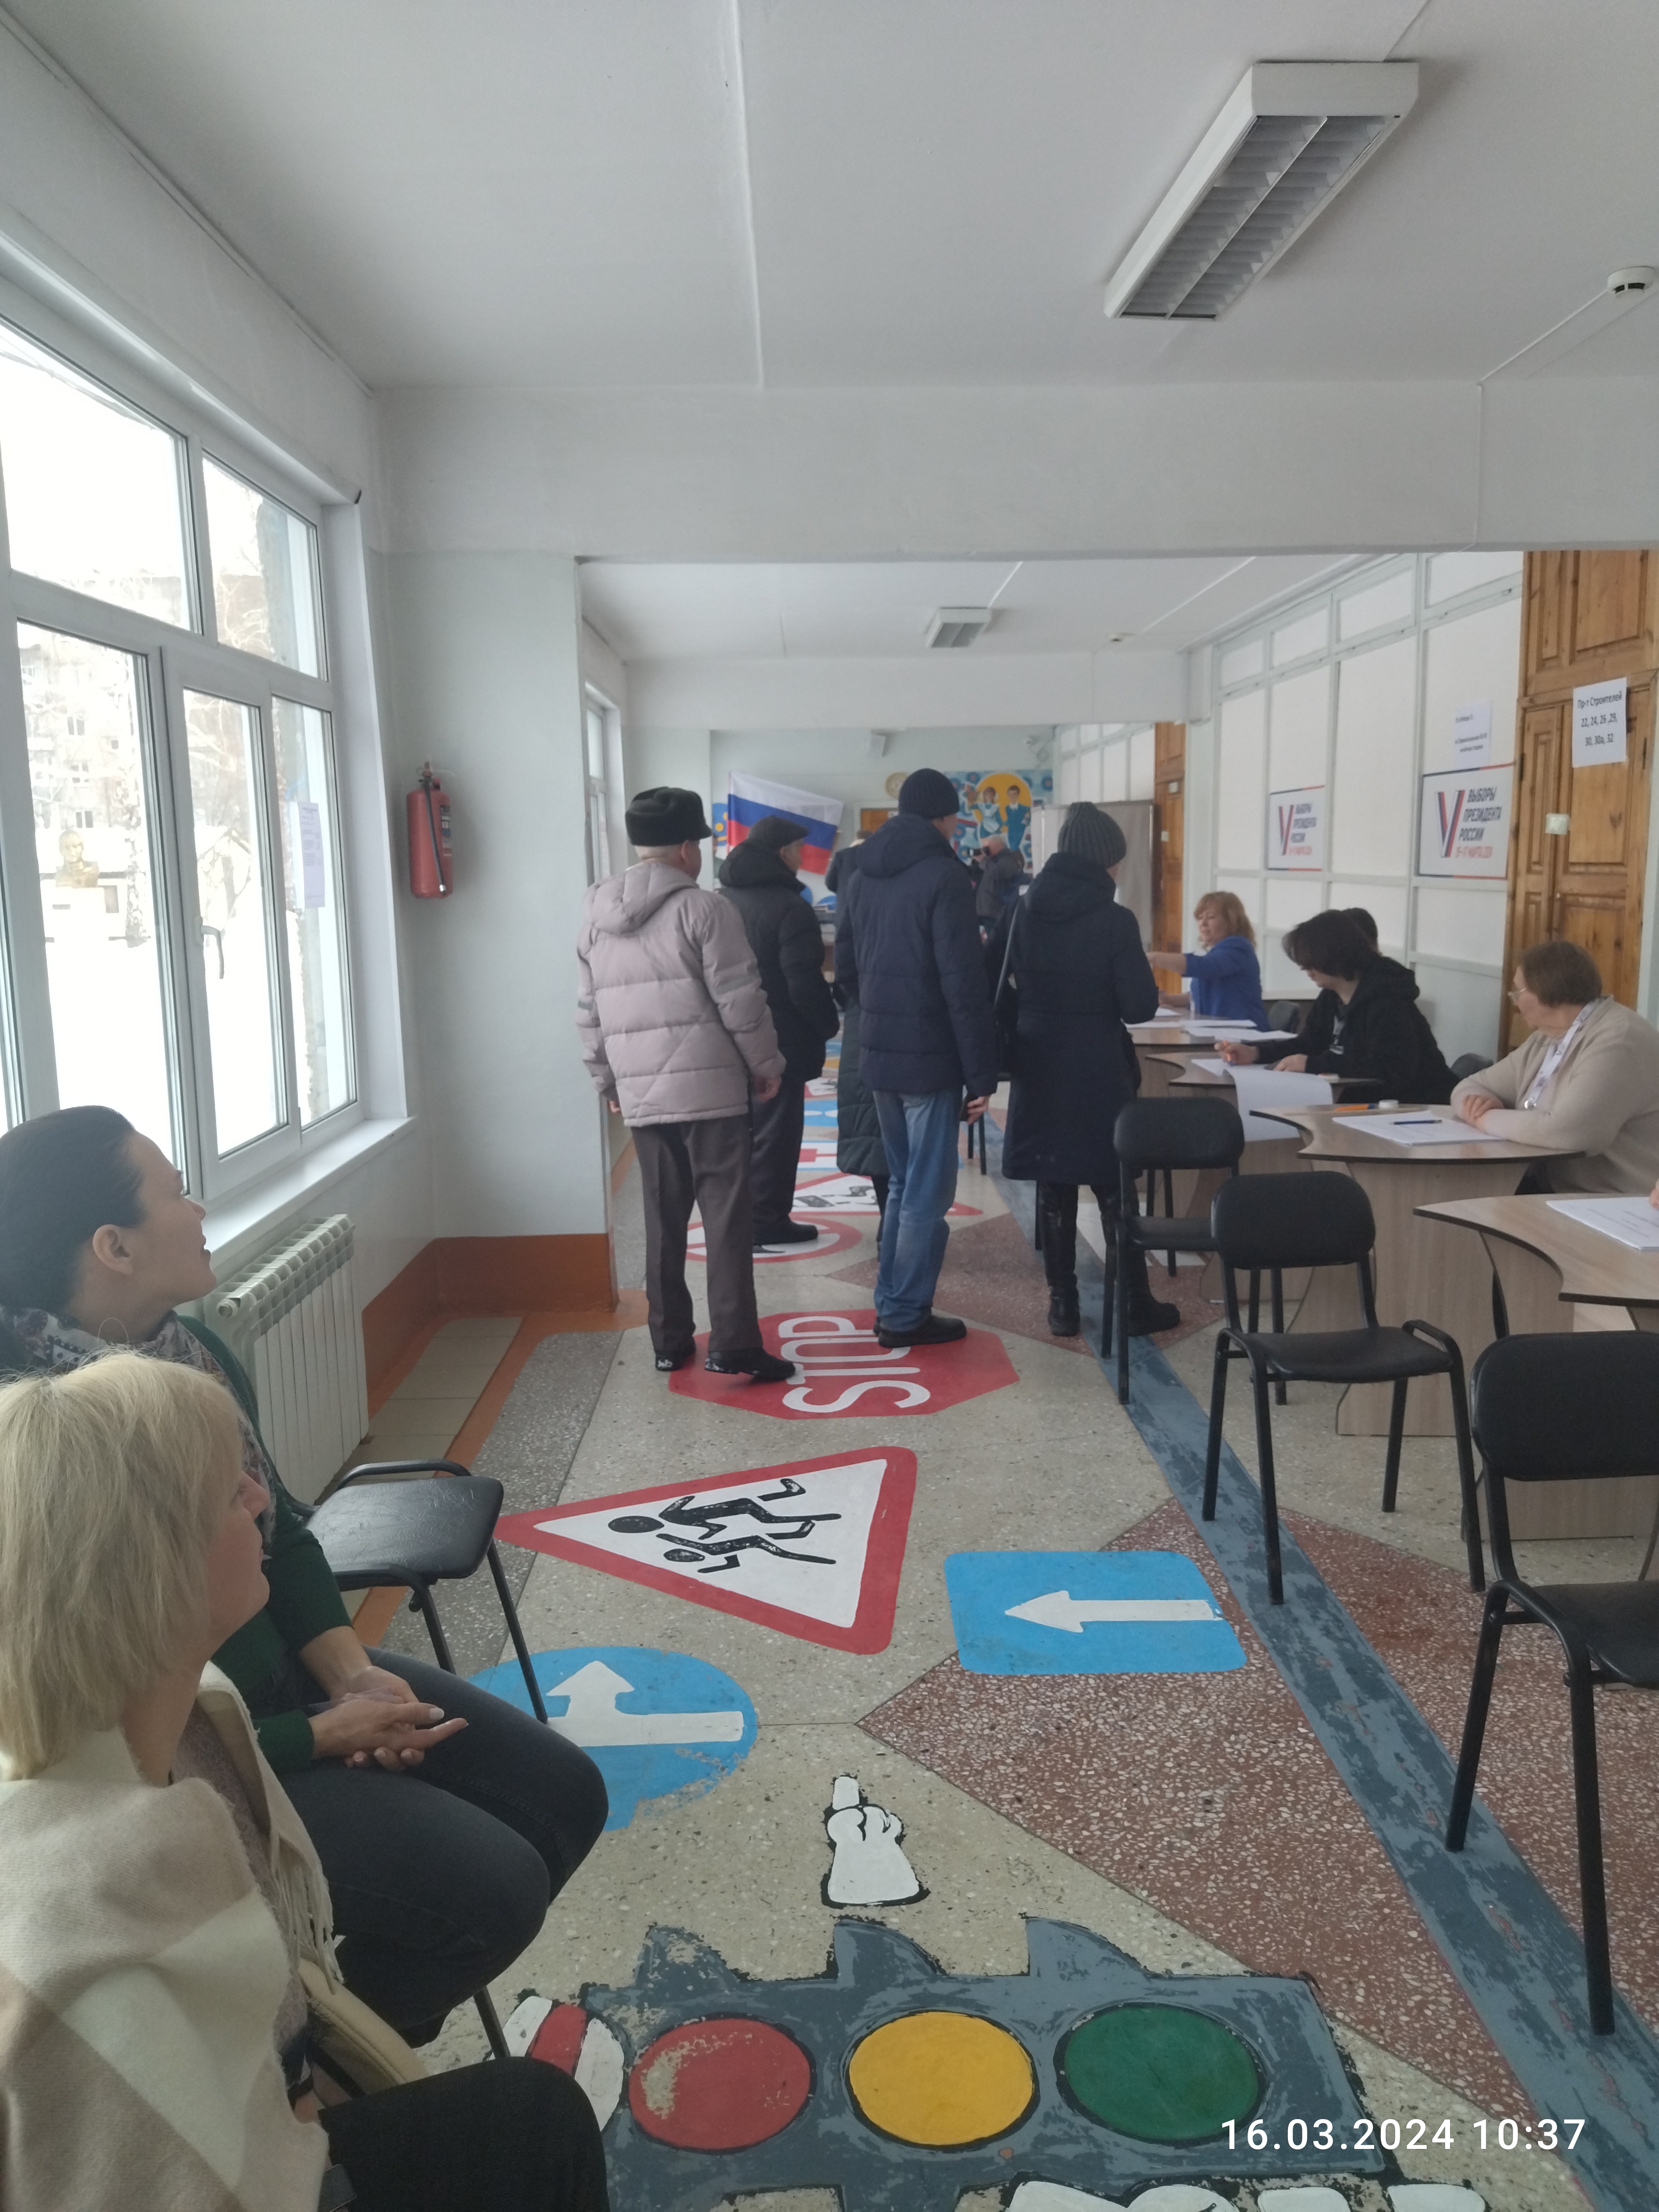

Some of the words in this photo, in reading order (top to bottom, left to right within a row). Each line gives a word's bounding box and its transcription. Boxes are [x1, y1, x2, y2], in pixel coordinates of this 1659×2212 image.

[1590, 691, 1622, 707] Строителей
[1467, 787, 1497, 803] ВЫБОРЫ
[1463, 806, 1502, 822] ПРЕЗИДЕНТА
[1458, 827, 1484, 841] РОССИИ
[778, 1316, 931, 1413] STOP
